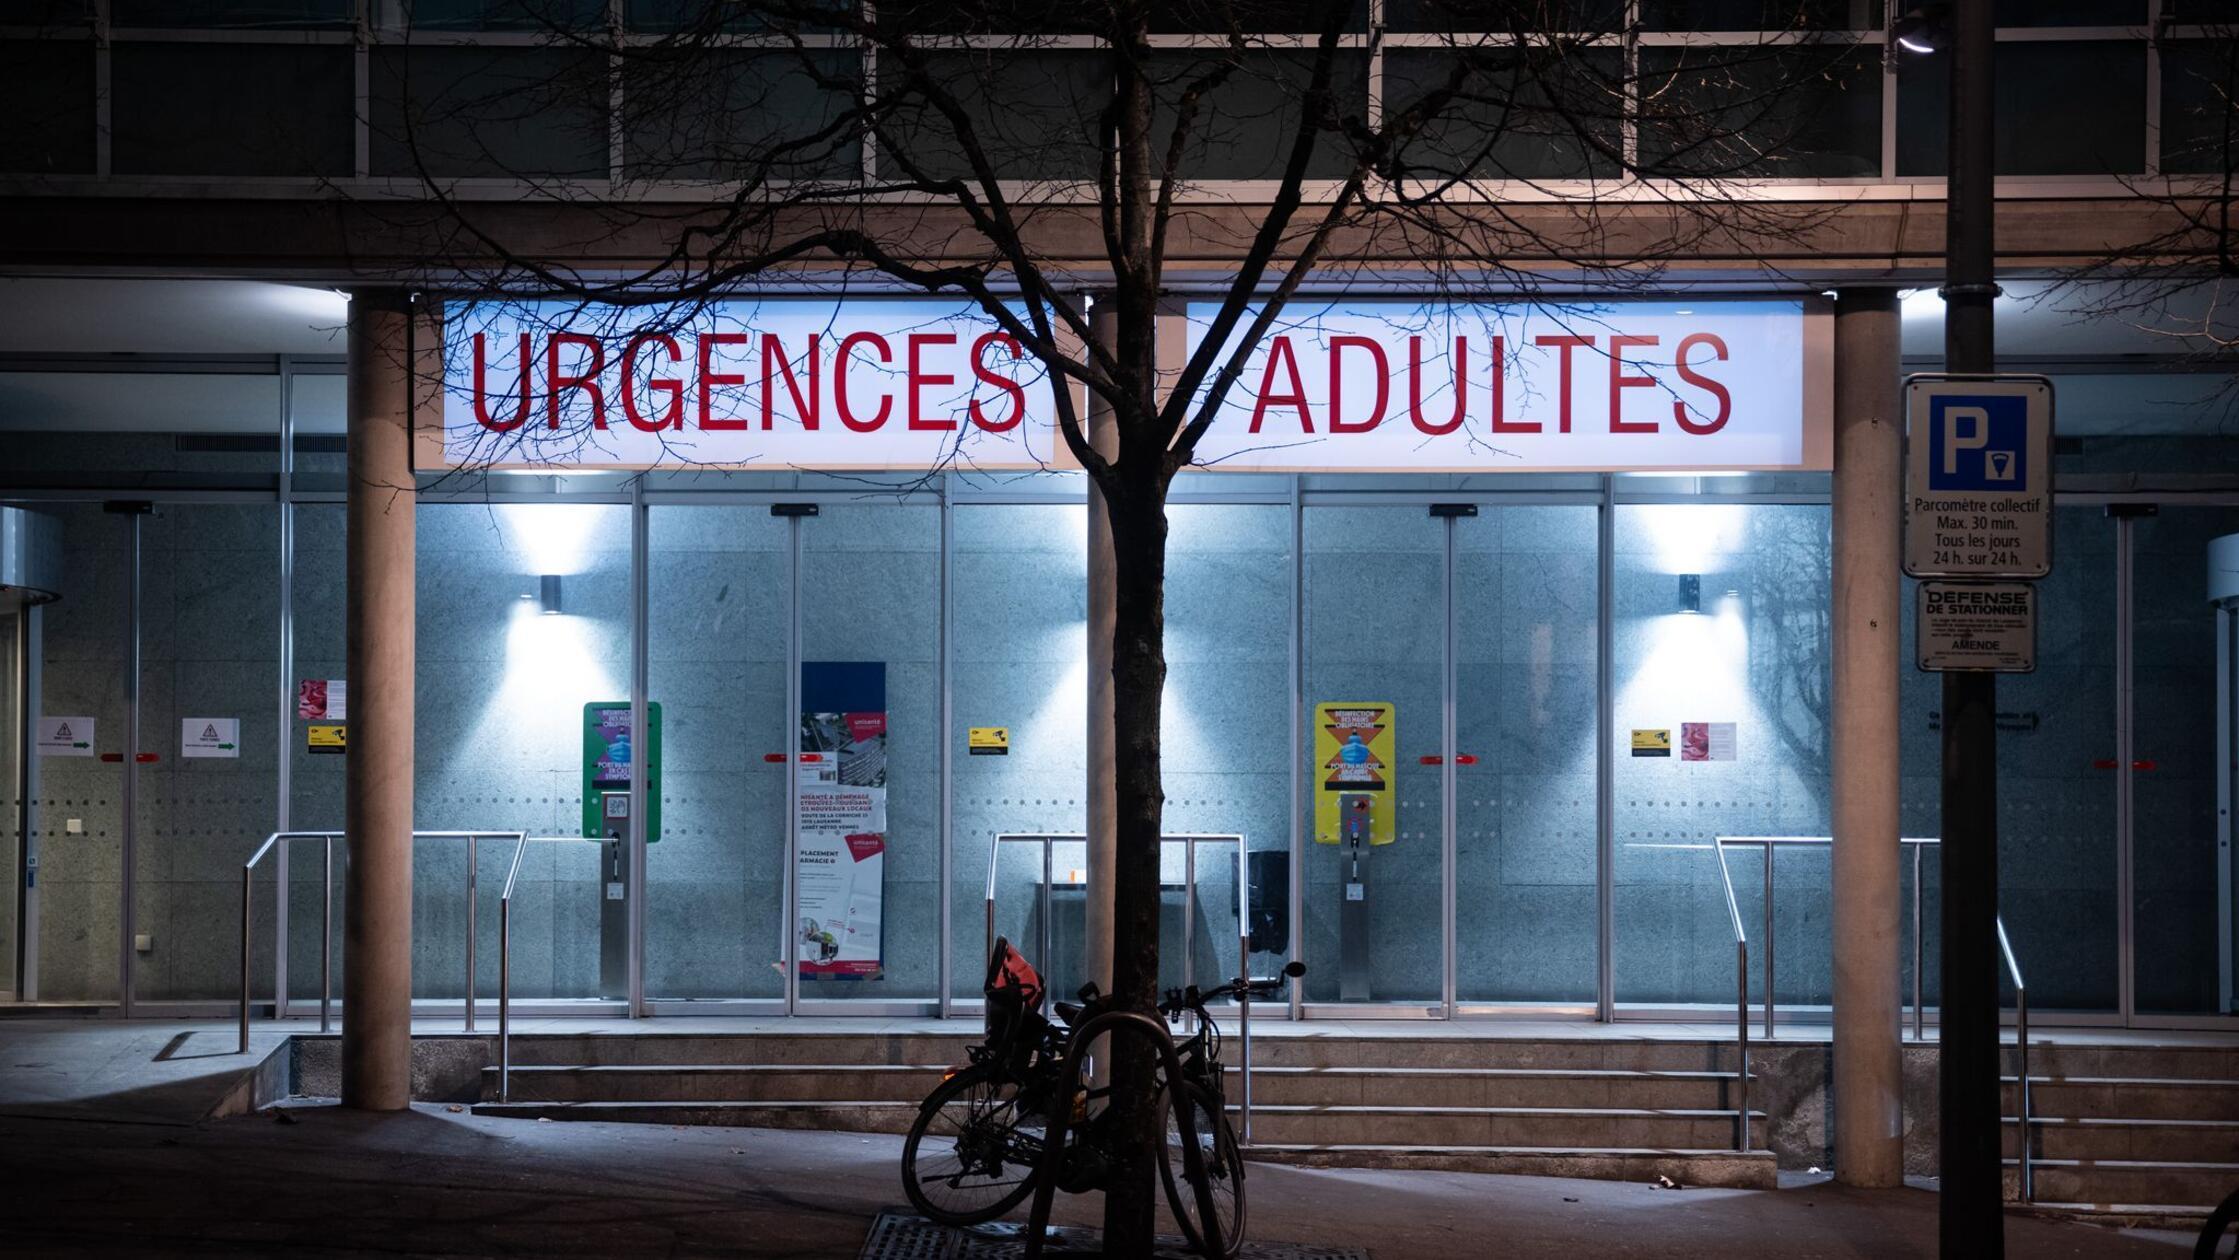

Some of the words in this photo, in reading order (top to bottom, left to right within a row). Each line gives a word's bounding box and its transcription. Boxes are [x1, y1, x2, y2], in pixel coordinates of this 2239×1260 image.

[473, 331, 1026, 434] URGENCES
[1248, 332, 1731, 435] ADULTES
[1944, 406, 1989, 474] P
[1914, 498, 1987, 512] Parcomètre
[1990, 498, 2041, 513] collectif
[1936, 516, 1968, 530] Max.
[1972, 516, 1988, 530] 30
[1991, 517, 2018, 530] min.
[1935, 533, 1965, 547] Tous
[1968, 533, 1986, 547] les
[1988, 534, 2021, 551] jours
[1933, 551, 1949, 564] 24
[1952, 550, 1964, 564] h.
[1967, 553, 1987, 565] sur
[1991, 551, 2006, 565] 24
[2010, 551, 2022, 566] h.
[1926, 604, 1943, 614] DE
[1948, 604, 2028, 615] STATIONNER
[1951, 640, 2000, 650] AMENDE
